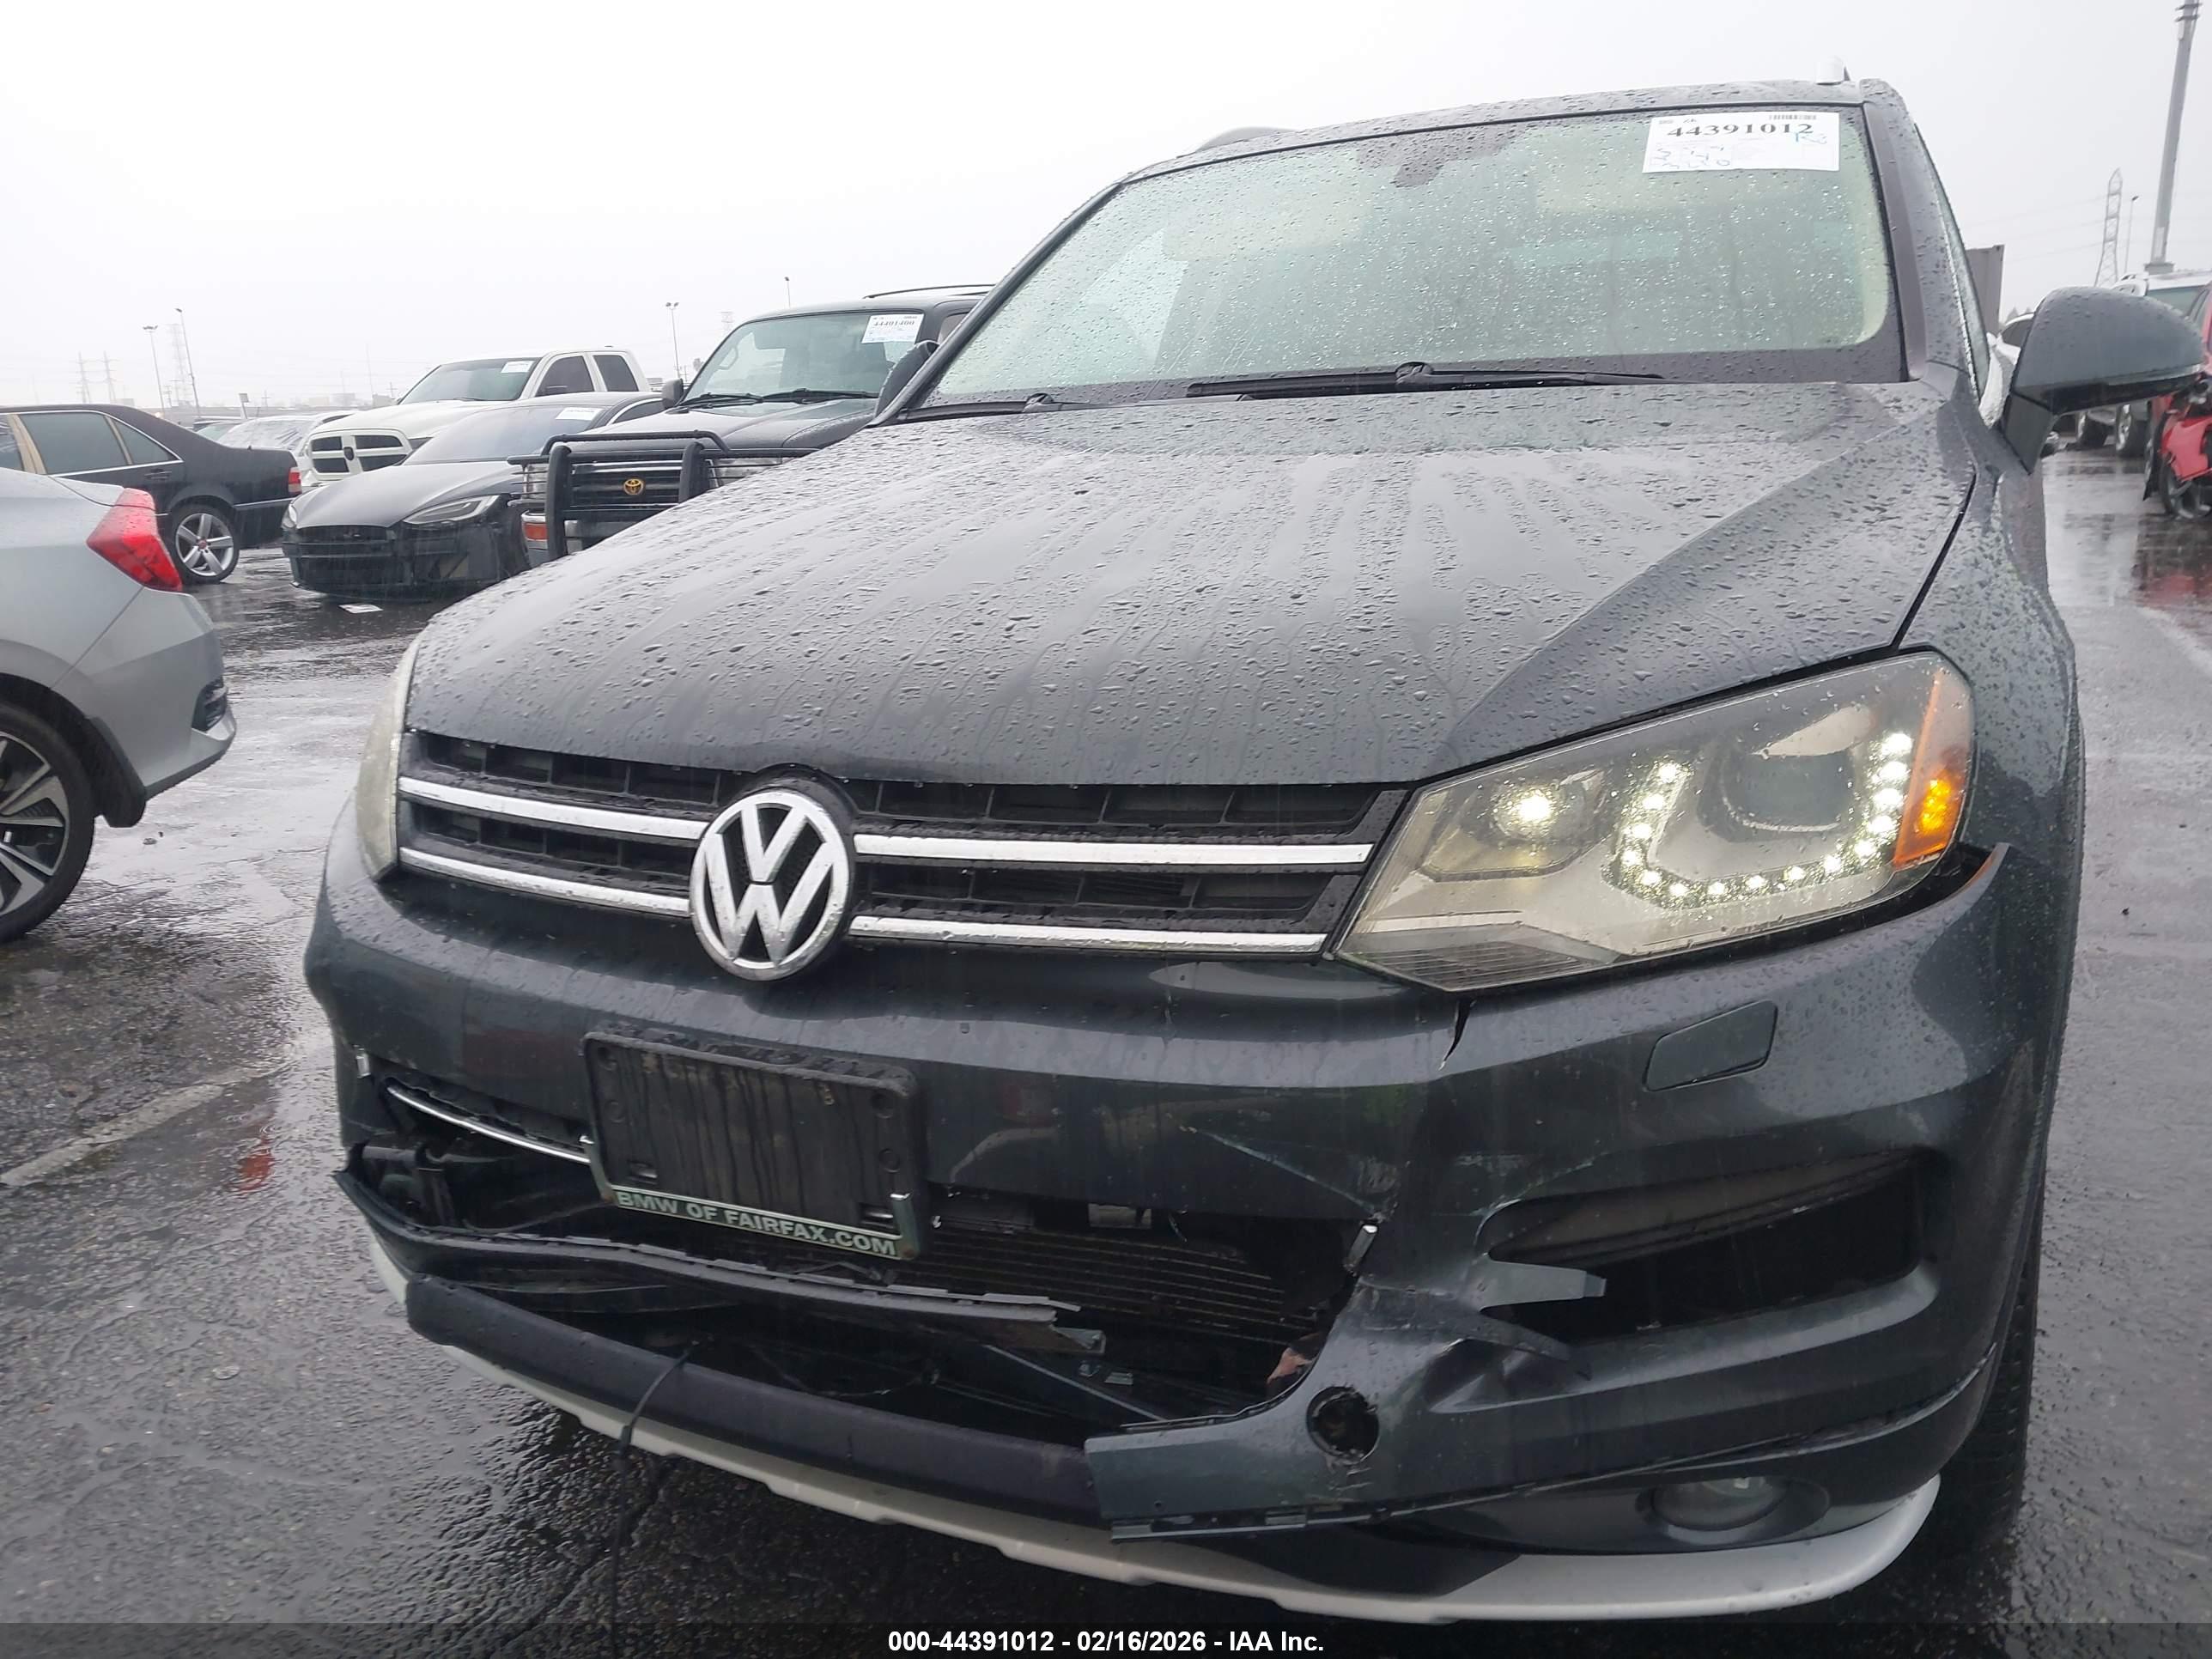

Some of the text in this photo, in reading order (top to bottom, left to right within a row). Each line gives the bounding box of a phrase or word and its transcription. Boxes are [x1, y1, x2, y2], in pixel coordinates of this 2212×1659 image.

[1667, 123, 1814, 137] 44391012
[690, 789, 849, 981] VW
[616, 1190, 897, 1256] BMW OF FAIRFAX.COM
